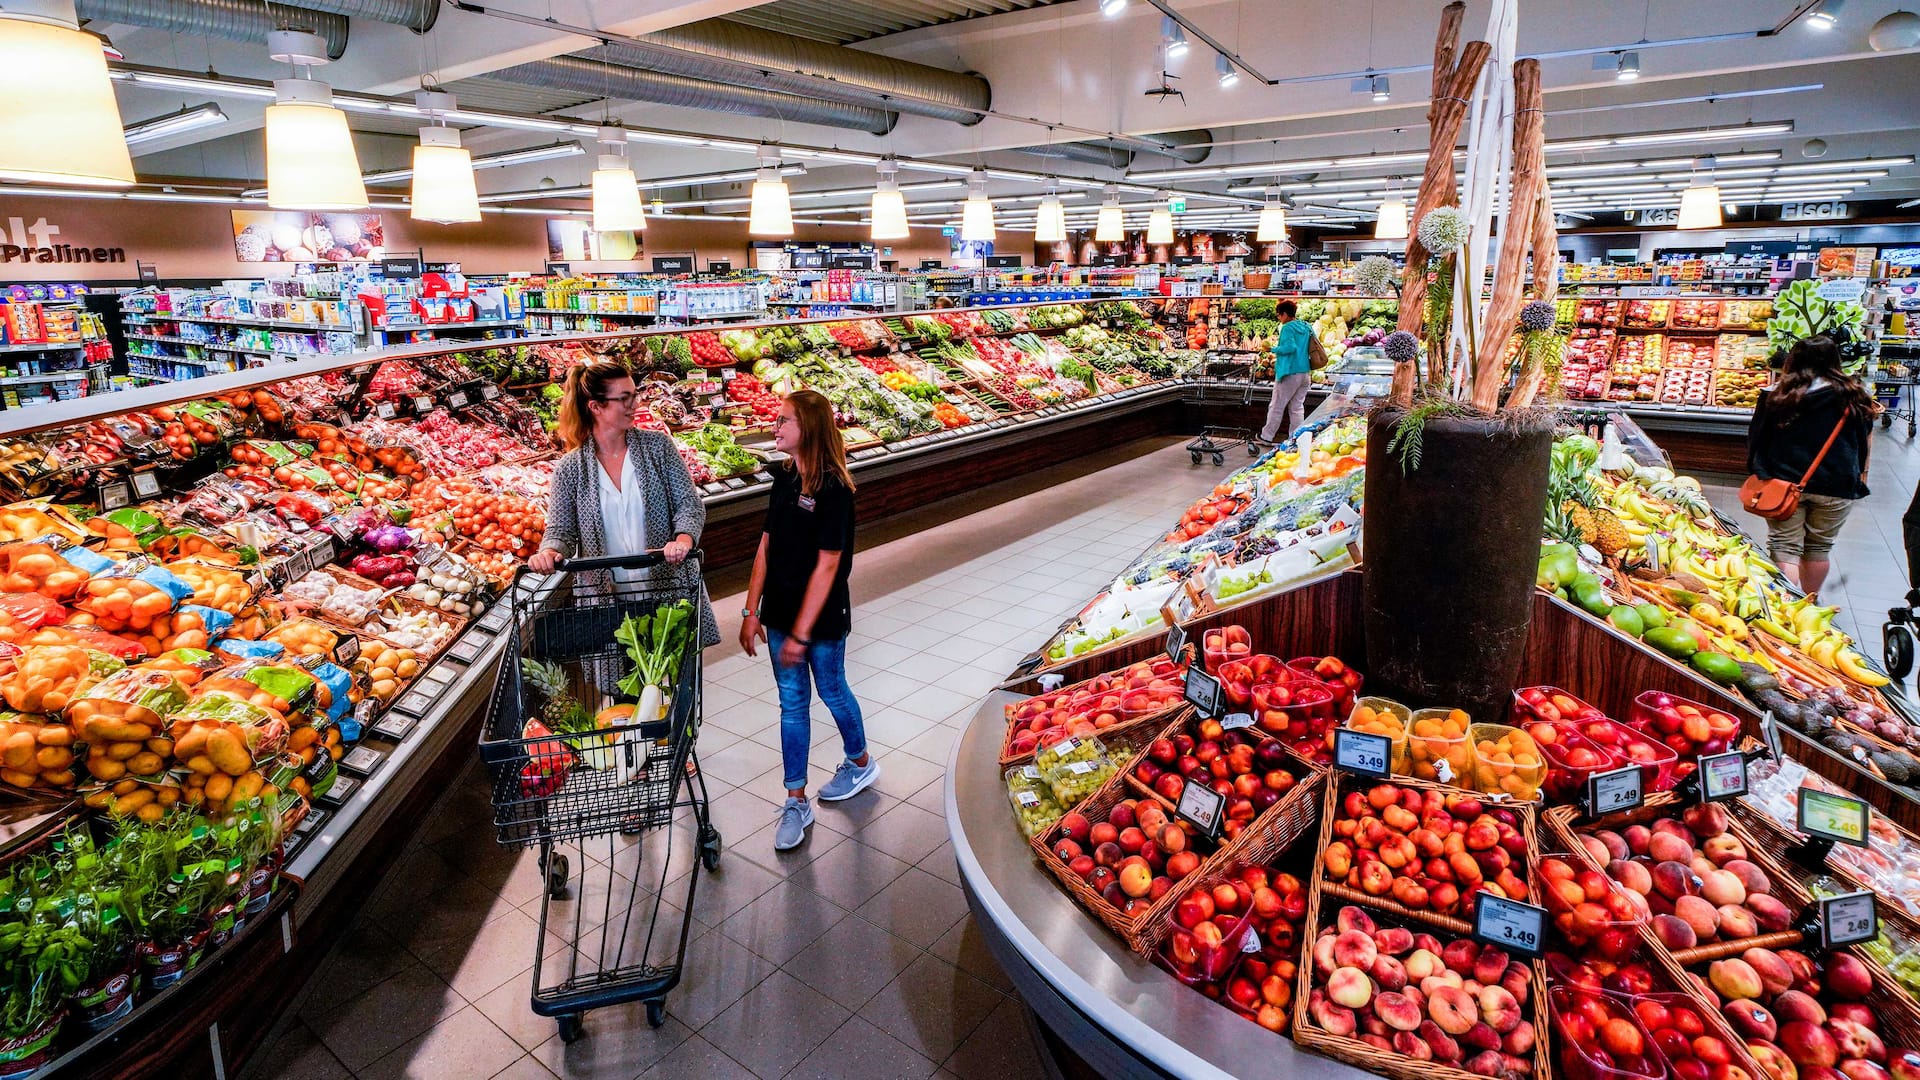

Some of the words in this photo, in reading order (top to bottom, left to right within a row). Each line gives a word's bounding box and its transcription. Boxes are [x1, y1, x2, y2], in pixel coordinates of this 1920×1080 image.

[1641, 208, 1680, 224] Käs
[1781, 200, 1848, 219] Fisch
[2, 244, 126, 262] Pralinen
[806, 257, 822, 265] NEU
[1358, 754, 1383, 768] 3.49
[1614, 790, 1637, 803] 2.49
[1193, 806, 1211, 823] 2.49
[1828, 818, 1858, 835] 2.49
[1848, 918, 1869, 932] 2.49
[1504, 926, 1536, 944] 3.49
